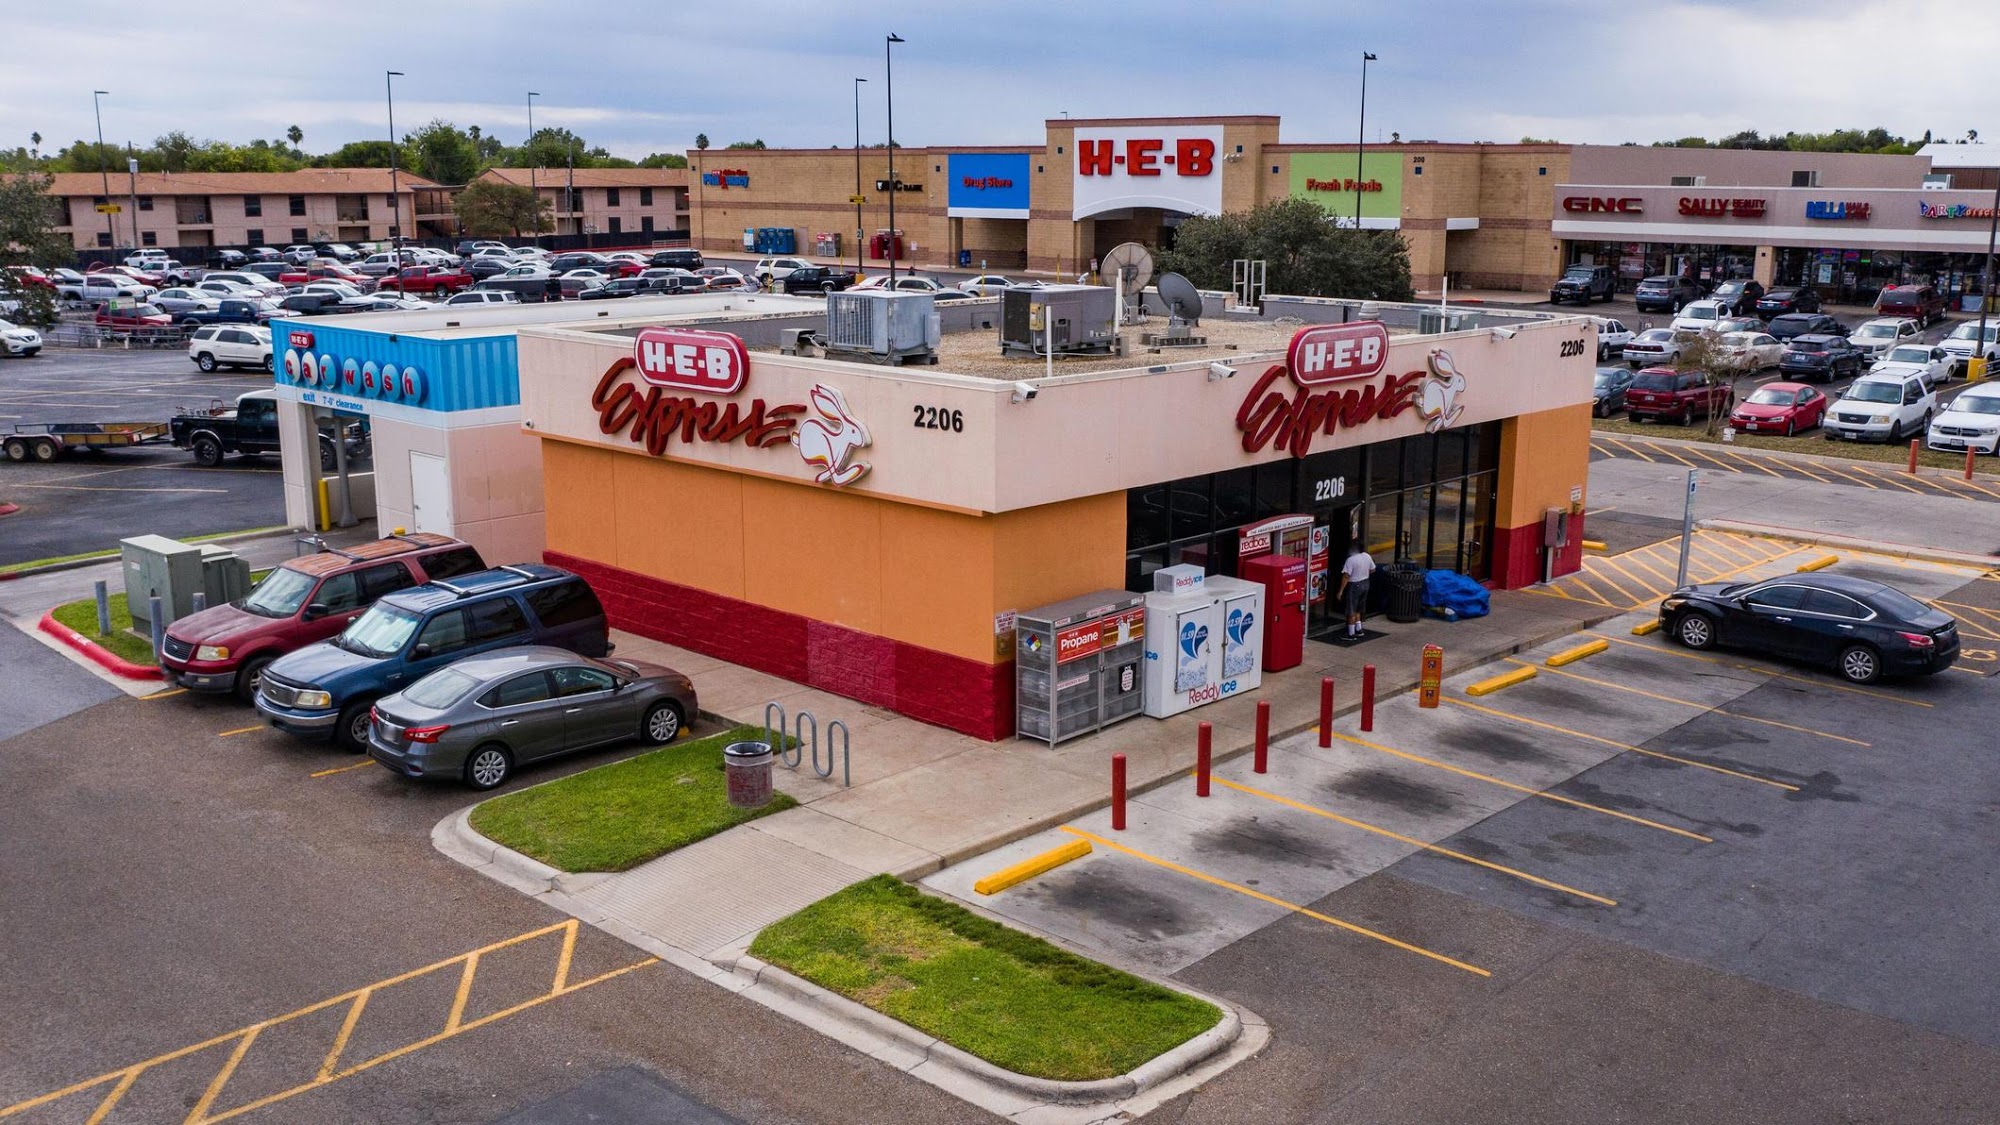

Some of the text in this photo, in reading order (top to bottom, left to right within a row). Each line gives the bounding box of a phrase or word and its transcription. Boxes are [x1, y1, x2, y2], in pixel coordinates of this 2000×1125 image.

[1078, 138, 1215, 176] H-E-B
[963, 176, 1012, 190] Drug Store
[1306, 179, 1382, 192] Fresh Foods
[1563, 196, 1643, 213] GNC
[1678, 197, 1730, 216] SALLY
[1732, 198, 1766, 209] BEAUTY
[1806, 201, 1845, 220] BELLA
[1919, 199, 1967, 219] PARTY
[1304, 336, 1381, 373] H-E-B
[1560, 339, 1585, 358] 2206
[643, 341, 731, 380] H-E-B
[285, 359, 415, 395] car wash
[303, 392, 315, 402] exit
[336, 400, 363, 411] clearance
[592, 357, 807, 456] Express
[913, 405, 963, 432] 2206
[1236, 365, 1426, 459] Express
[1315, 476, 1345, 501] 2206
[1061, 631, 1099, 651] Propane
